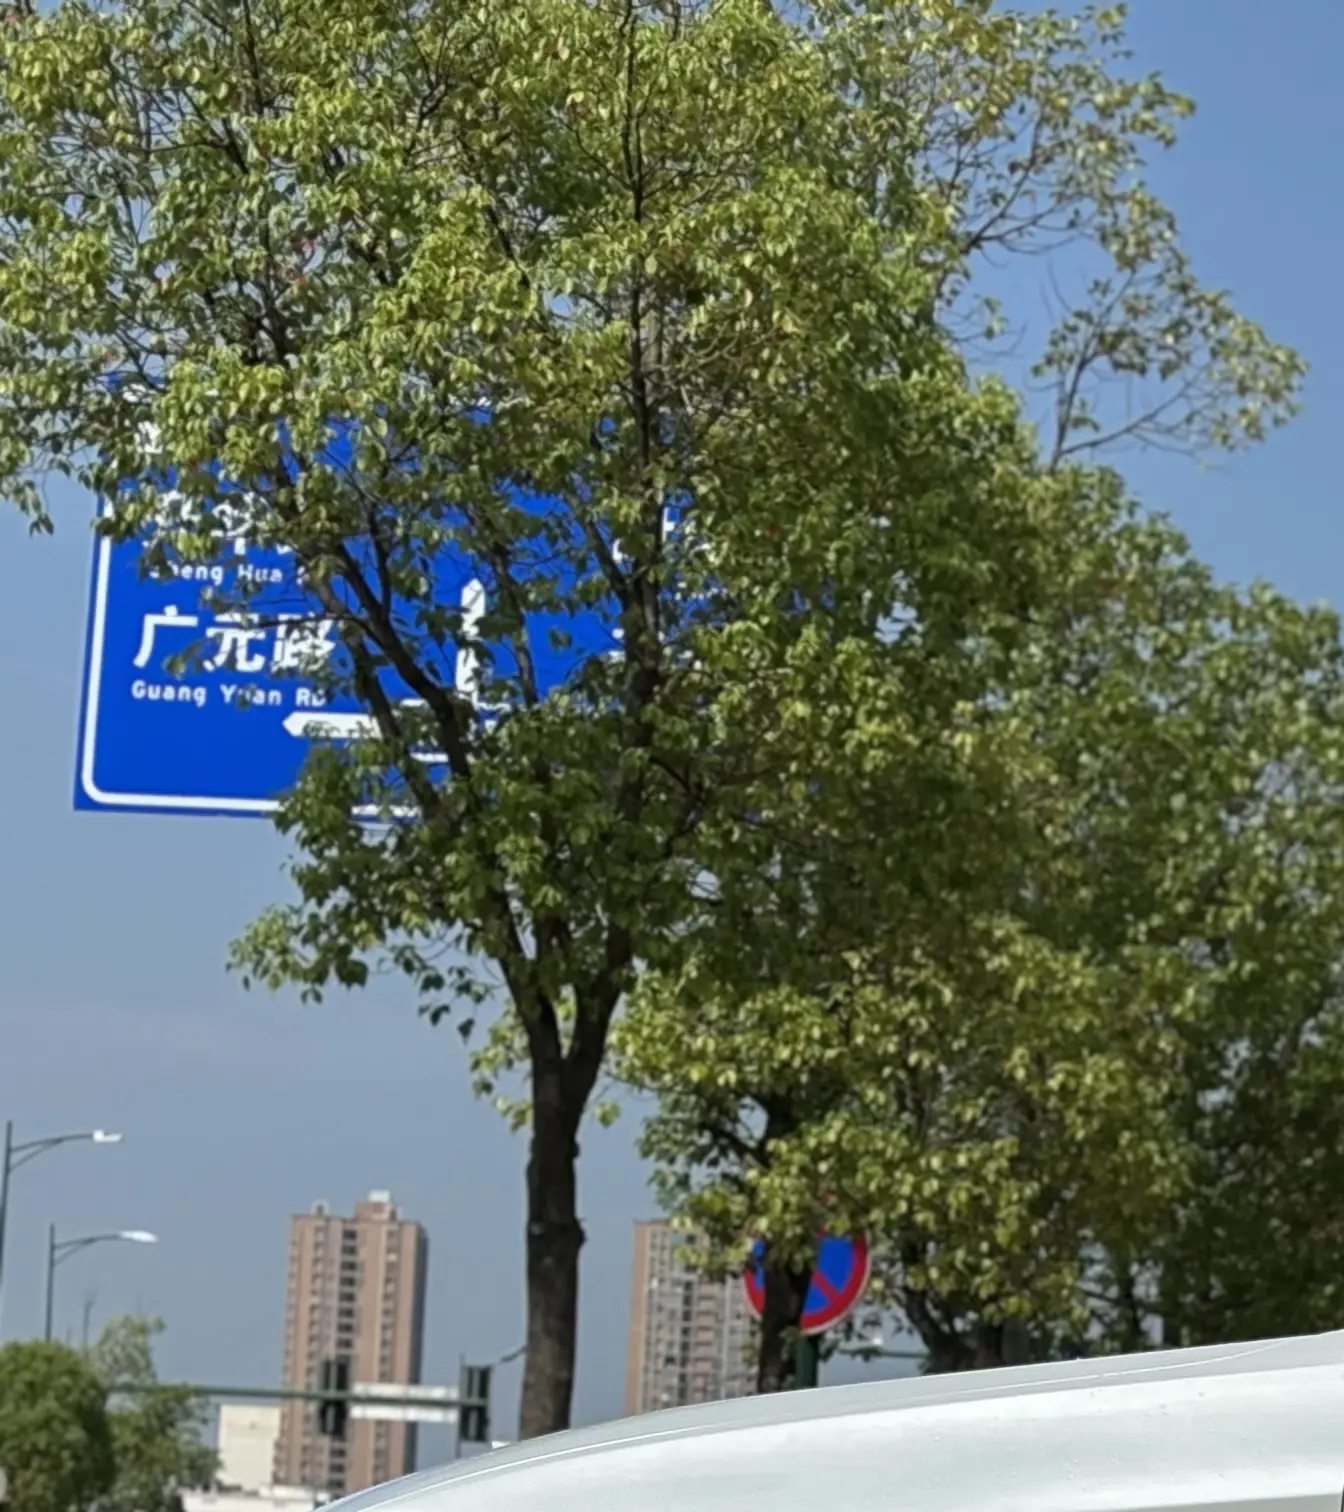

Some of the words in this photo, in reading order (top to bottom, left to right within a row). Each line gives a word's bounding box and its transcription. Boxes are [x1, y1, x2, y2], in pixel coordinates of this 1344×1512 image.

[150, 560, 223, 586] heng
[237, 563, 283, 583] Hua
[133, 604, 337, 674] 广元路
[131, 679, 207, 707] Guang
